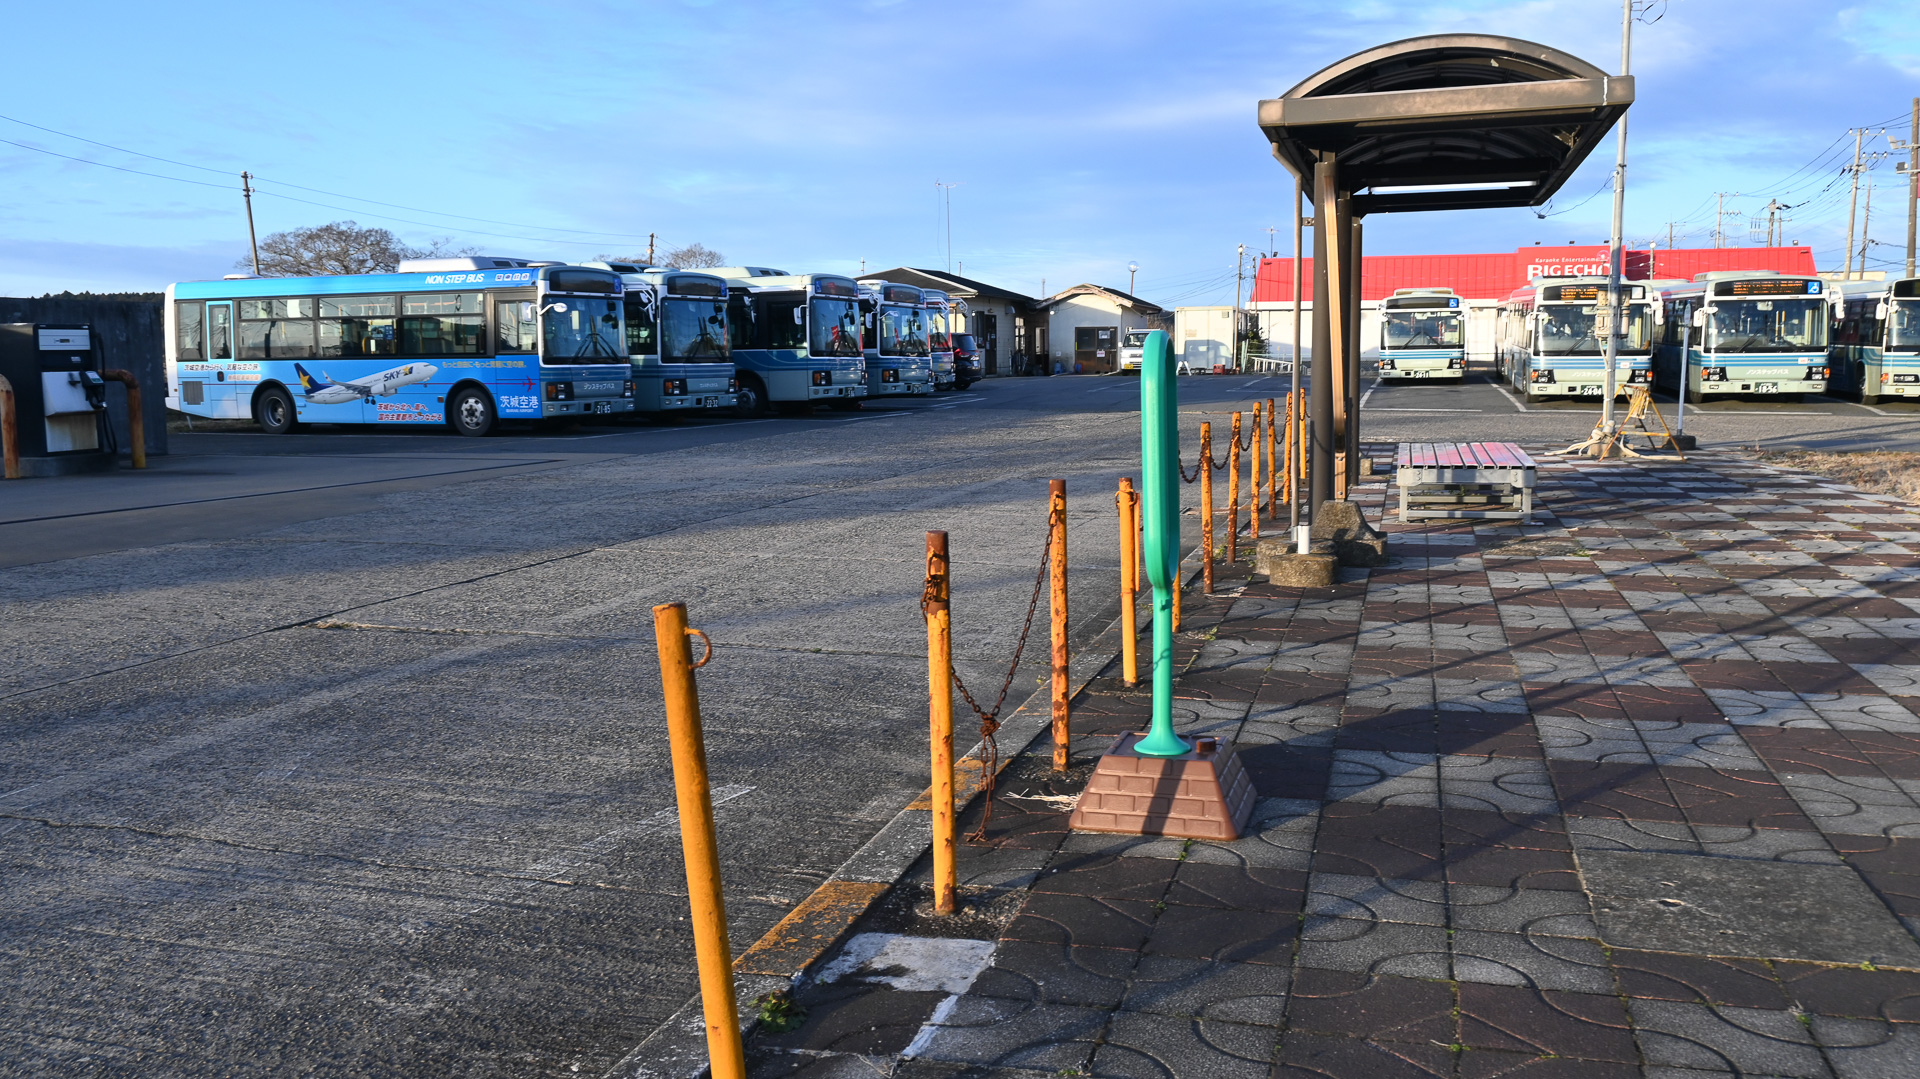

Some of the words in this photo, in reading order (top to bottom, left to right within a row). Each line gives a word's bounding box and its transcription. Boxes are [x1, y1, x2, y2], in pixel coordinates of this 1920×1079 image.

[425, 275, 444, 285] NON
[444, 274, 466, 284] STEP
[466, 273, 484, 283] BUS
[1527, 264, 1561, 281] BIG
[1564, 264, 1612, 276] ECHO
[383, 369, 401, 382] SKY
[500, 395, 539, 408] 茨城空港
